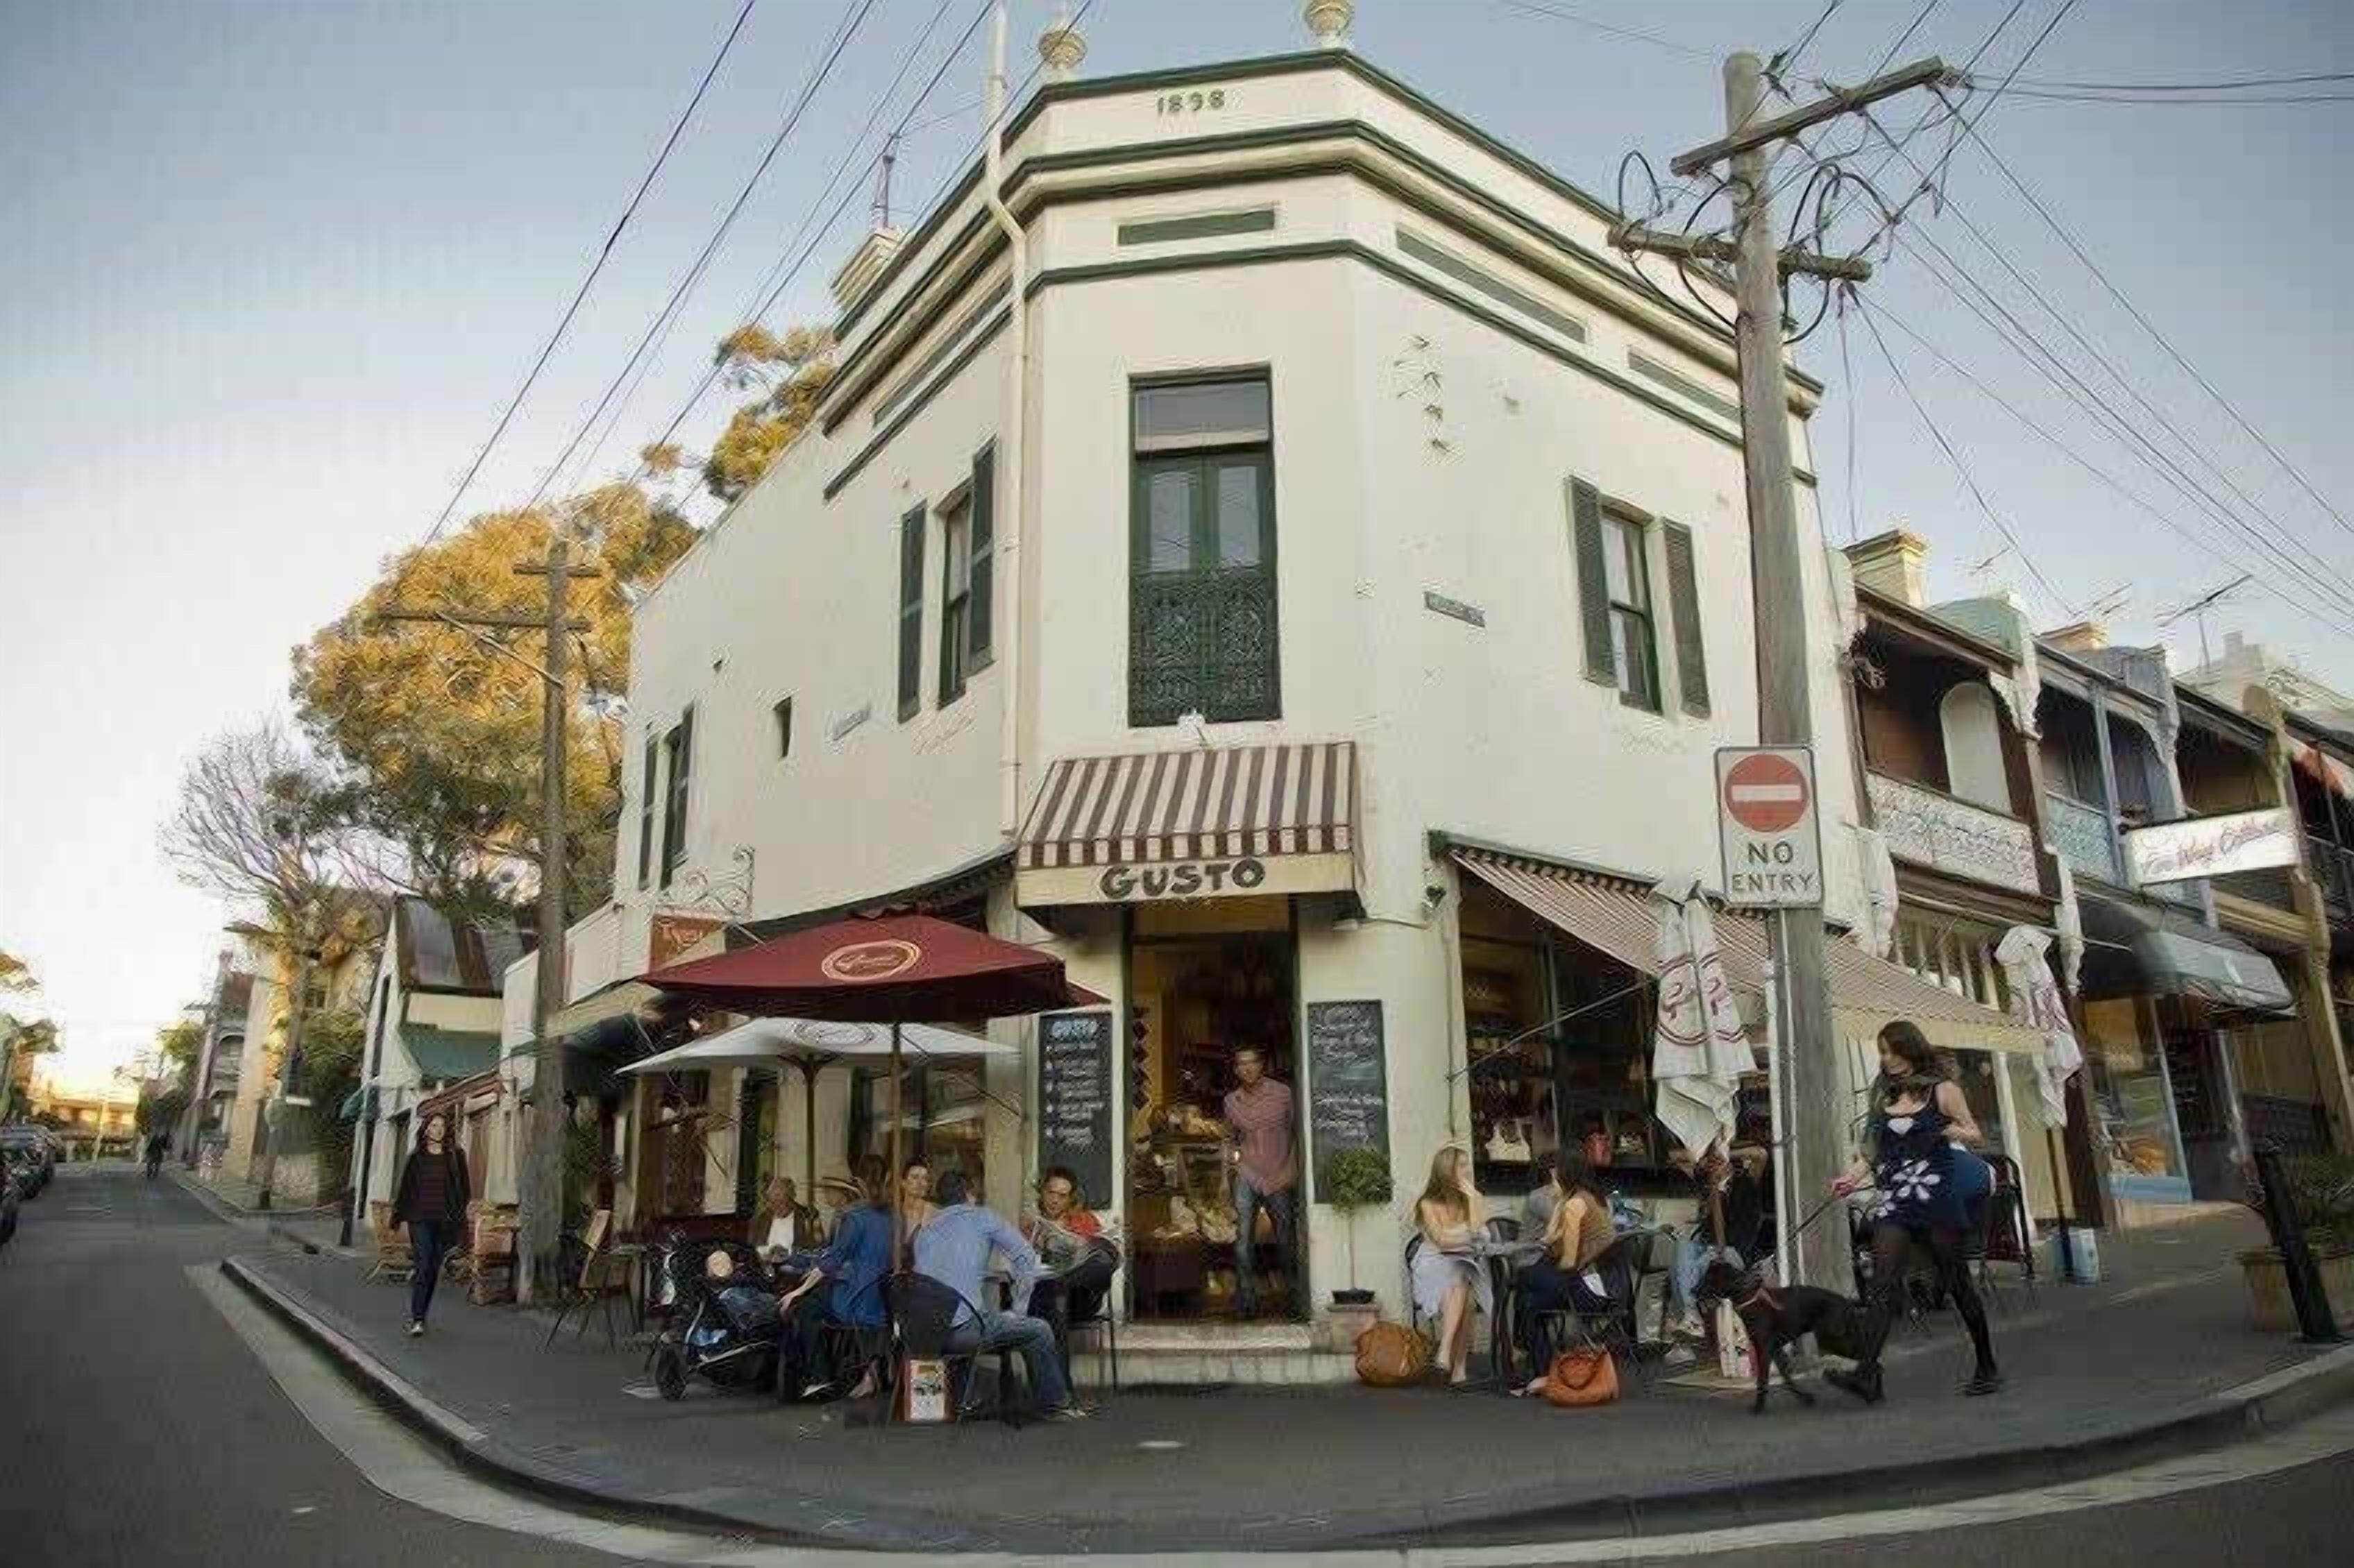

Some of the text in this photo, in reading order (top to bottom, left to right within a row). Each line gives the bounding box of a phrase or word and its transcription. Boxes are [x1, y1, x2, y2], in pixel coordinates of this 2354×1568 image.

[1747, 840, 1793, 864] NO
[1100, 858, 1266, 900] GUSTO
[1731, 871, 1815, 892] ENTRY
